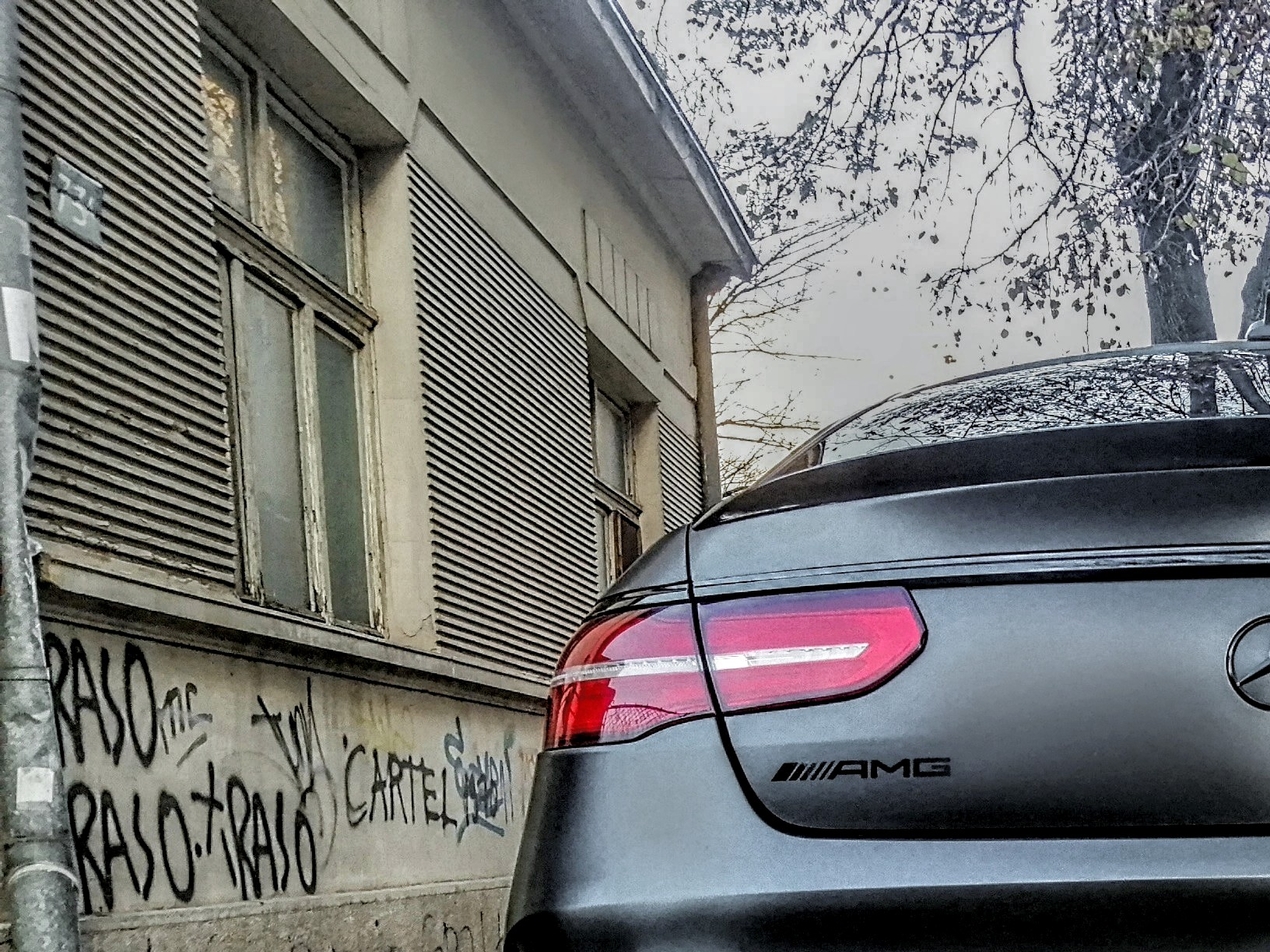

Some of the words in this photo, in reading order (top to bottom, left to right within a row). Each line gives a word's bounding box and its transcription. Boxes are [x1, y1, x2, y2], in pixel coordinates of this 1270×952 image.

[44, 632, 159, 768] RASO
[345, 743, 458, 832] CARTEL
[827, 757, 951, 781] AMG
